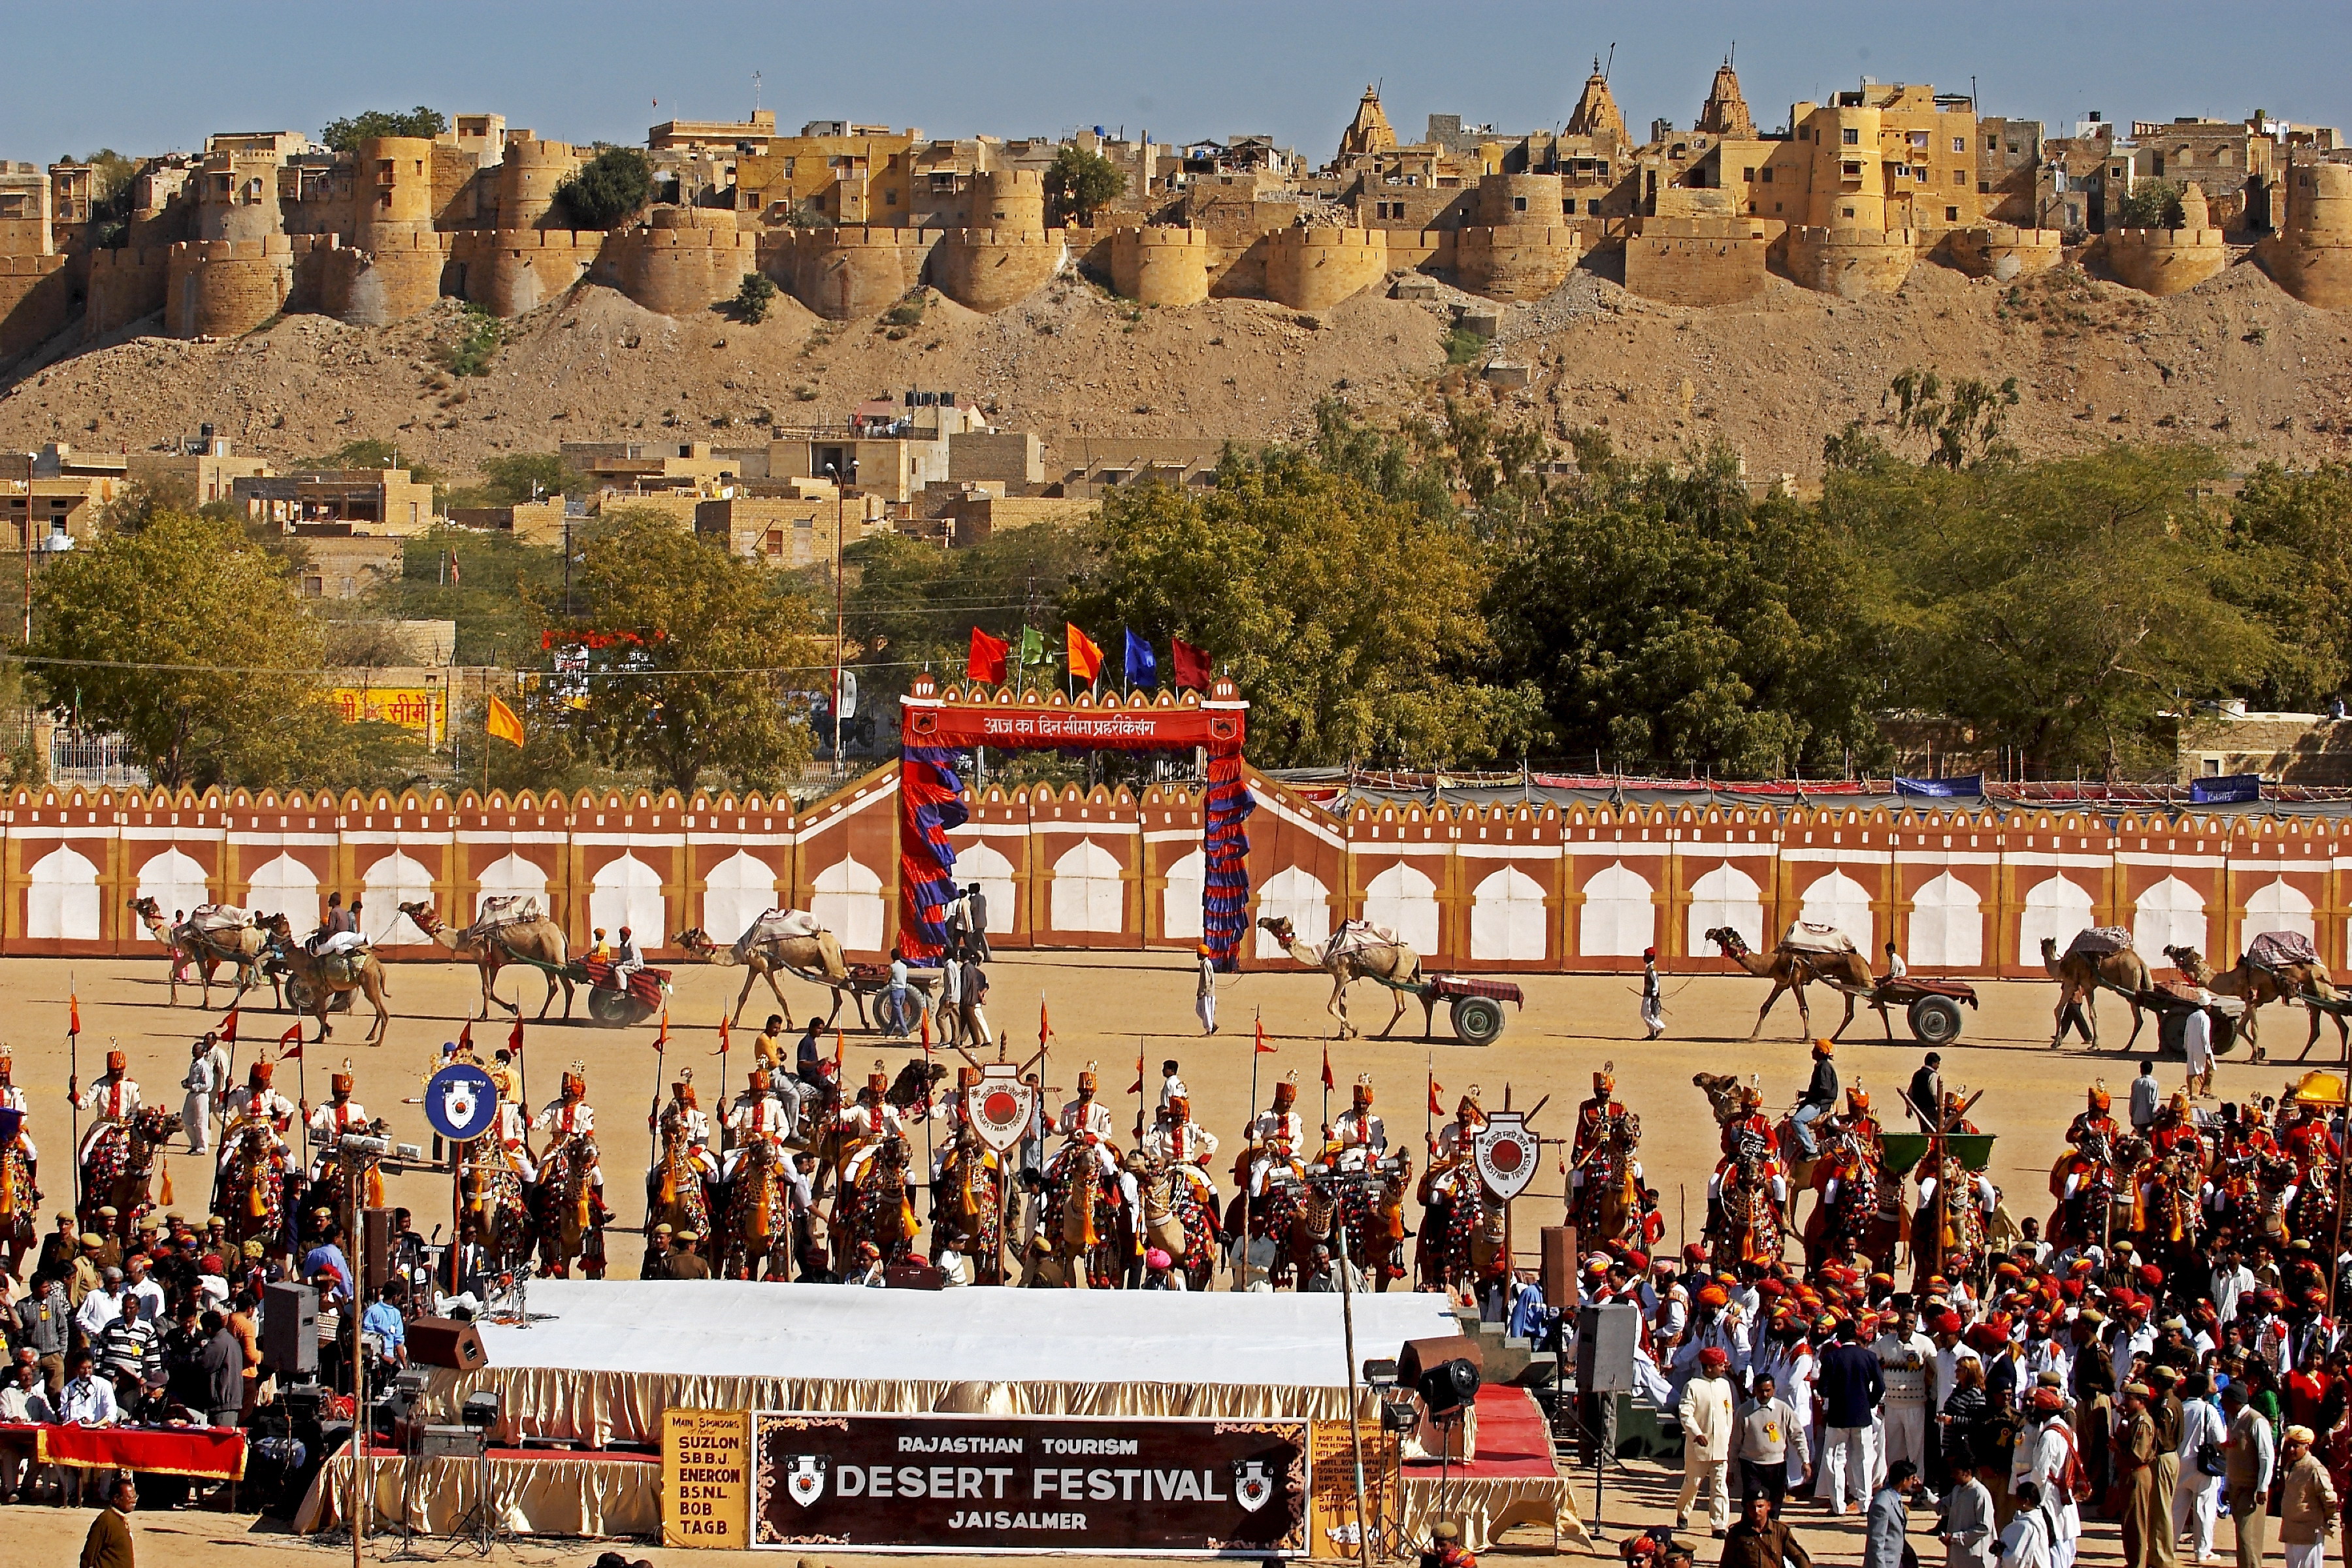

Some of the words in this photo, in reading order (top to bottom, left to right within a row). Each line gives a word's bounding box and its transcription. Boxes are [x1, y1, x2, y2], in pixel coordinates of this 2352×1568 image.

[984, 717, 1013, 734] आज
[1015, 718, 1035, 734] का
[1037, 715, 1062, 736] दिन
[1063, 714, 1092, 736] सीमा
[679, 1436, 739, 1449] SUZLON
[898, 1436, 1023, 1454] RAJASTHAN
[1041, 1438, 1137, 1455] TOURISM
[680, 1452, 730, 1465] S.B.B.J.
[679, 1468, 741, 1483] ENERCON
[837, 1465, 1013, 1499] DESERT
[1034, 1468, 1227, 1501] FESTIVAL
[680, 1486, 730, 1499] B.S.N.L.
[680, 1501, 714, 1516] B.O.B.
[680, 1520, 730, 1535] T.A.G.B.
[949, 1510, 1088, 1531] JAISALMER
